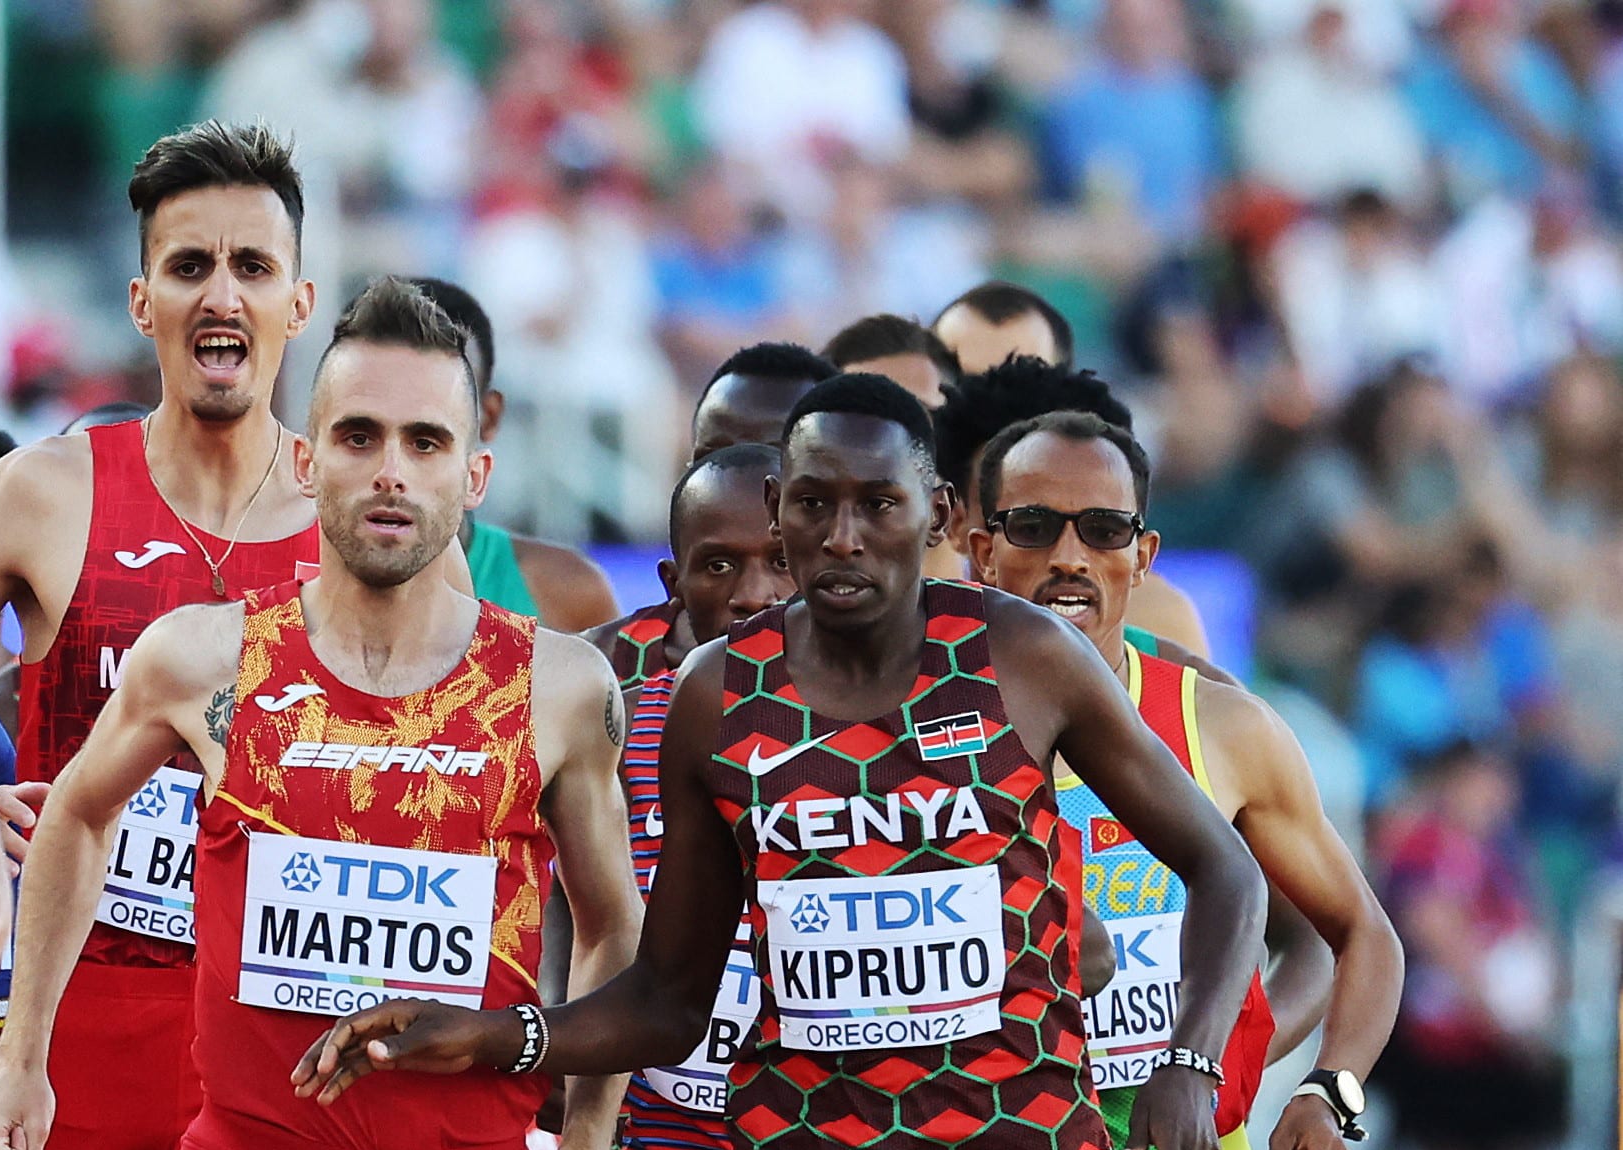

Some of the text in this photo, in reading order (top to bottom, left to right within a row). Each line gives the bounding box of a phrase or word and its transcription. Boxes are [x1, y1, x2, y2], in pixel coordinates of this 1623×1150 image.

[278, 741, 489, 777] ESPAÑA
[751, 786, 990, 853] KENYA
[146, 837, 196, 892] BA
[324, 855, 460, 908] TDK
[1082, 861, 1171, 914] REA
[829, 884, 968, 932] TDK
[258, 905, 473, 976] MARTOS
[781, 937, 990, 1000] KIPRUTO
[807, 1013, 967, 1047] OREGON22
